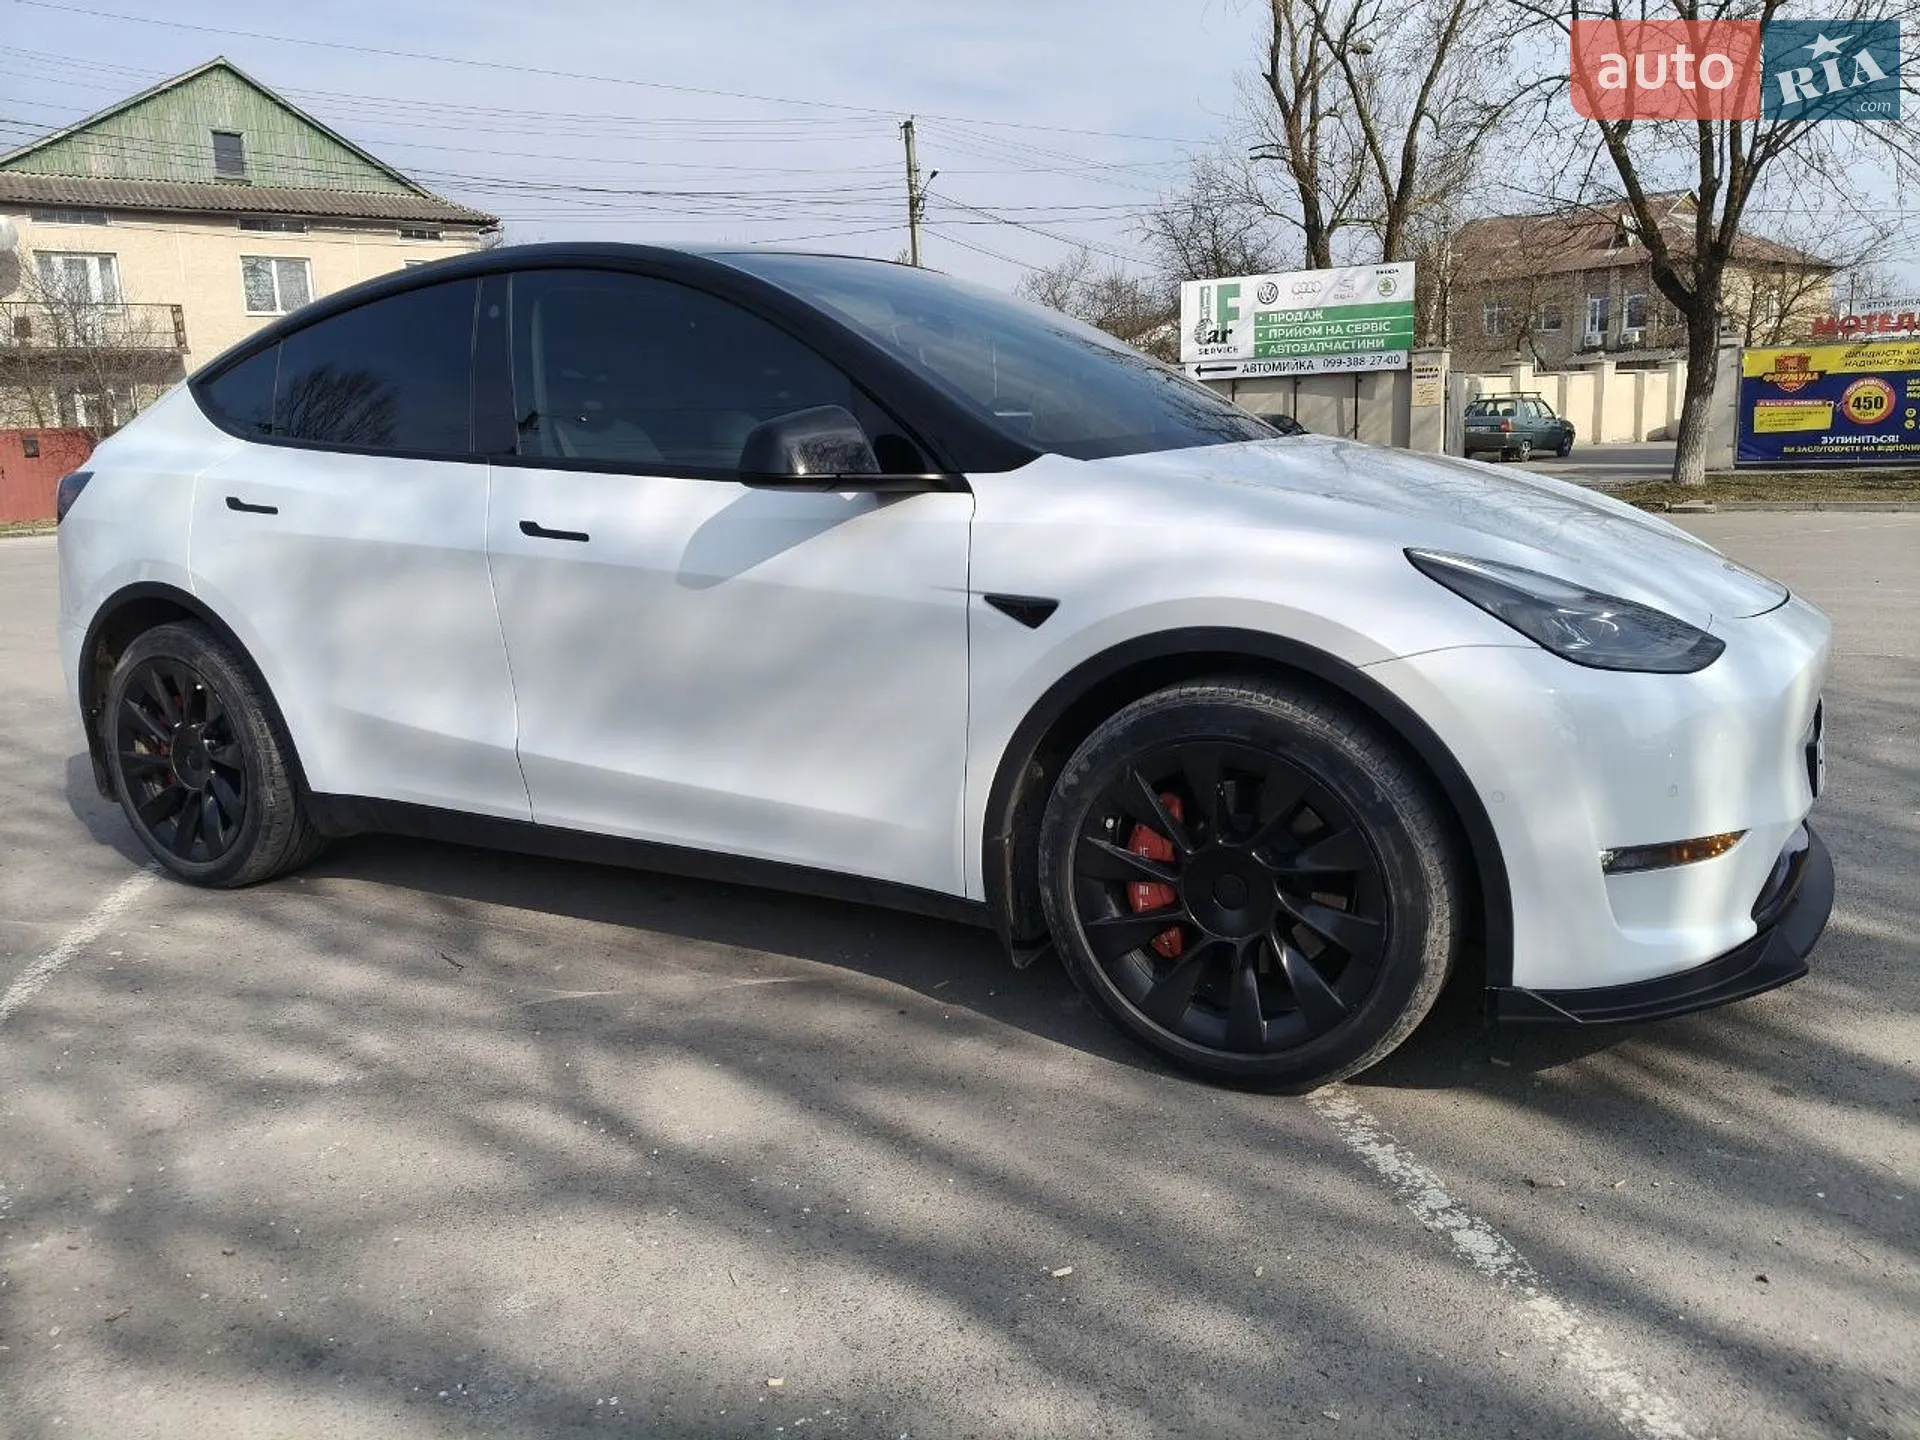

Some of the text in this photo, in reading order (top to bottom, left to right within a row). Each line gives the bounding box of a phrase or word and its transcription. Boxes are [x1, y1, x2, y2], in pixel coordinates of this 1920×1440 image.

[1268, 310, 1324, 323] ПРОДАЖ
[1268, 321, 1392, 339] ПРИЙОМ НА СЕРВІС
[1198, 346, 1239, 356] SERVICE
[1268, 338, 1385, 355] АВТОЗАПЧАСТИНИ
[1242, 354, 1401, 374] АВТОМИЙКА 099-388-27-00
[1851, 396, 1884, 411] 450
[1821, 434, 1900, 445] ЗУПИНІТЬСЯ!
